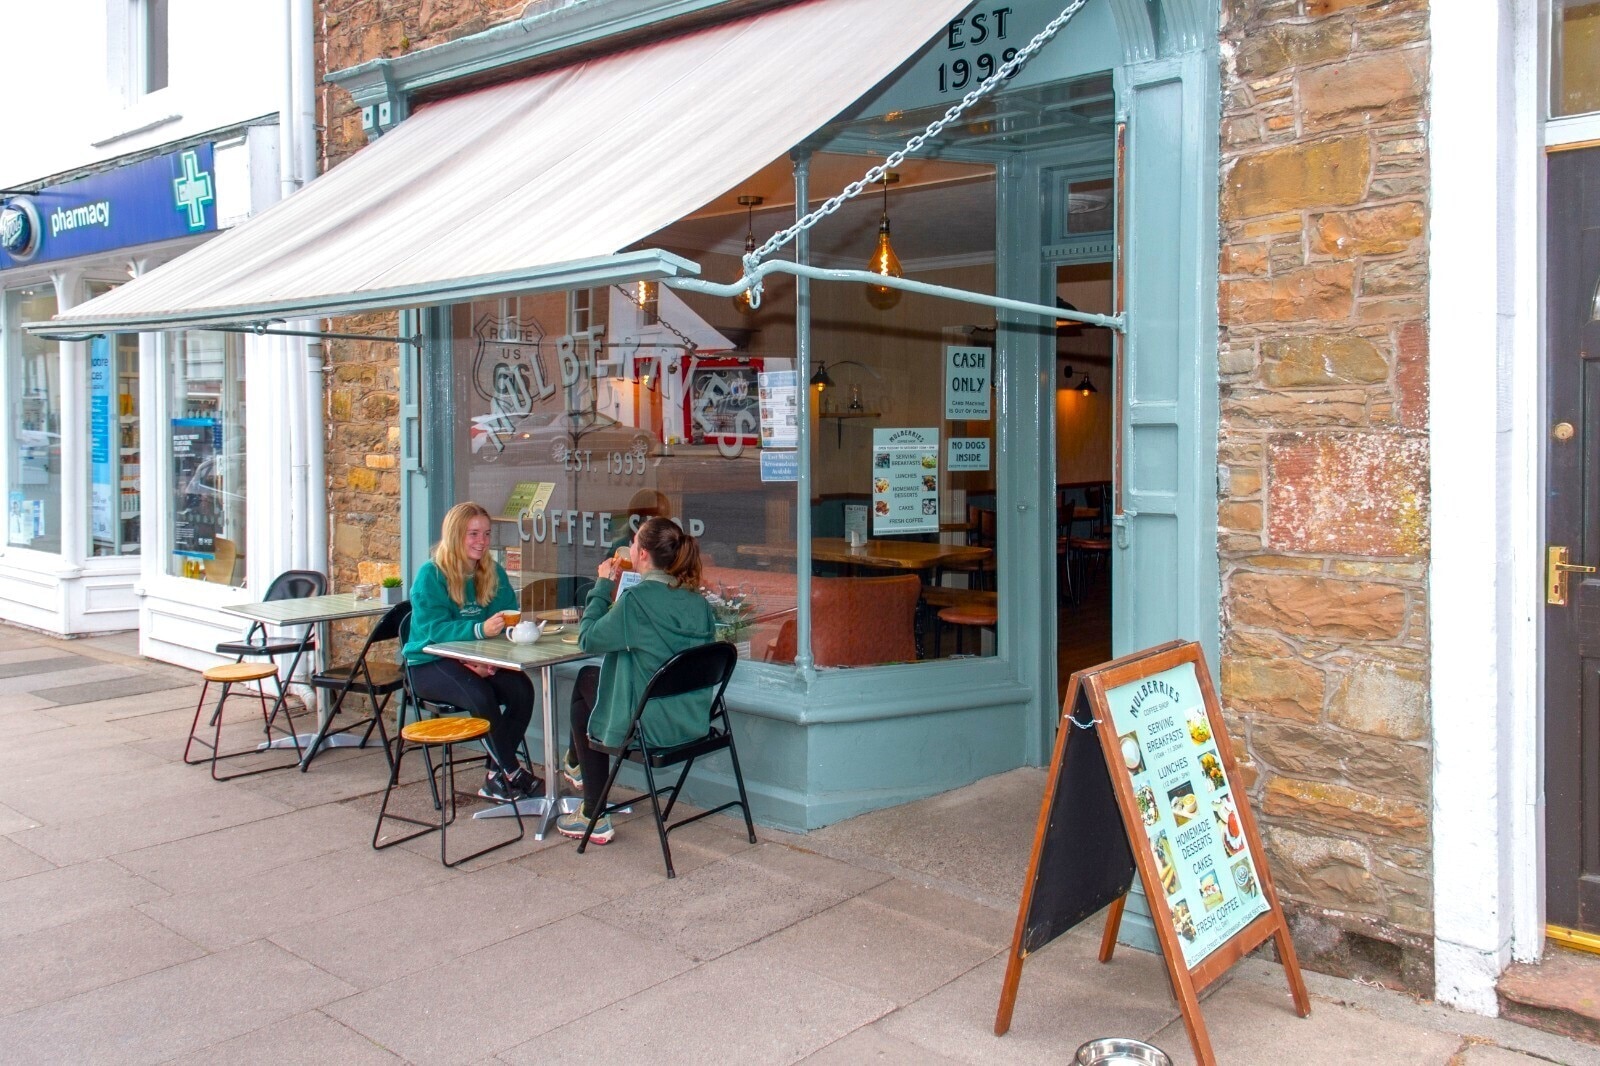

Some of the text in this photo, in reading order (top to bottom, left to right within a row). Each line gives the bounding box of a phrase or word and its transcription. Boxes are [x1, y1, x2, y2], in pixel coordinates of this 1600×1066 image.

[948, 7, 1012, 51] EST
[938, 47, 1023, 93] 1999
[51, 201, 110, 237] pharmacy
[489, 327, 533, 342] ROUTE
[502, 349, 521, 360] US
[952, 352, 986, 368] CASH
[484, 324, 756, 460] MULBERRIES
[952, 377, 985, 392] ONLY
[889, 430, 925, 443] MULBERRIES
[952, 442, 986, 450] NO DOGS
[564, 449, 647, 475] EST. 1999
[956, 454, 982, 462] INSIDE
[517, 508, 613, 549] COFFEE
[629, 513, 706, 546] SP
[1130, 680, 1180, 718] MULBERRIES
[1144, 700, 1170, 716] COFFEE SHOP
[1148, 716, 1174, 736] SERVING
[1146, 728, 1184, 752] BREAKFASTS
[1158, 756, 1188, 779] LUNCHES
[1176, 818, 1212, 848] HOMEMADE
[1182, 833, 1213, 860] DESSERTS
[1192, 854, 1214, 874] CAKES
[1196, 912, 1216, 936] FRESH
[1216, 896, 1240, 920] COFFEE
